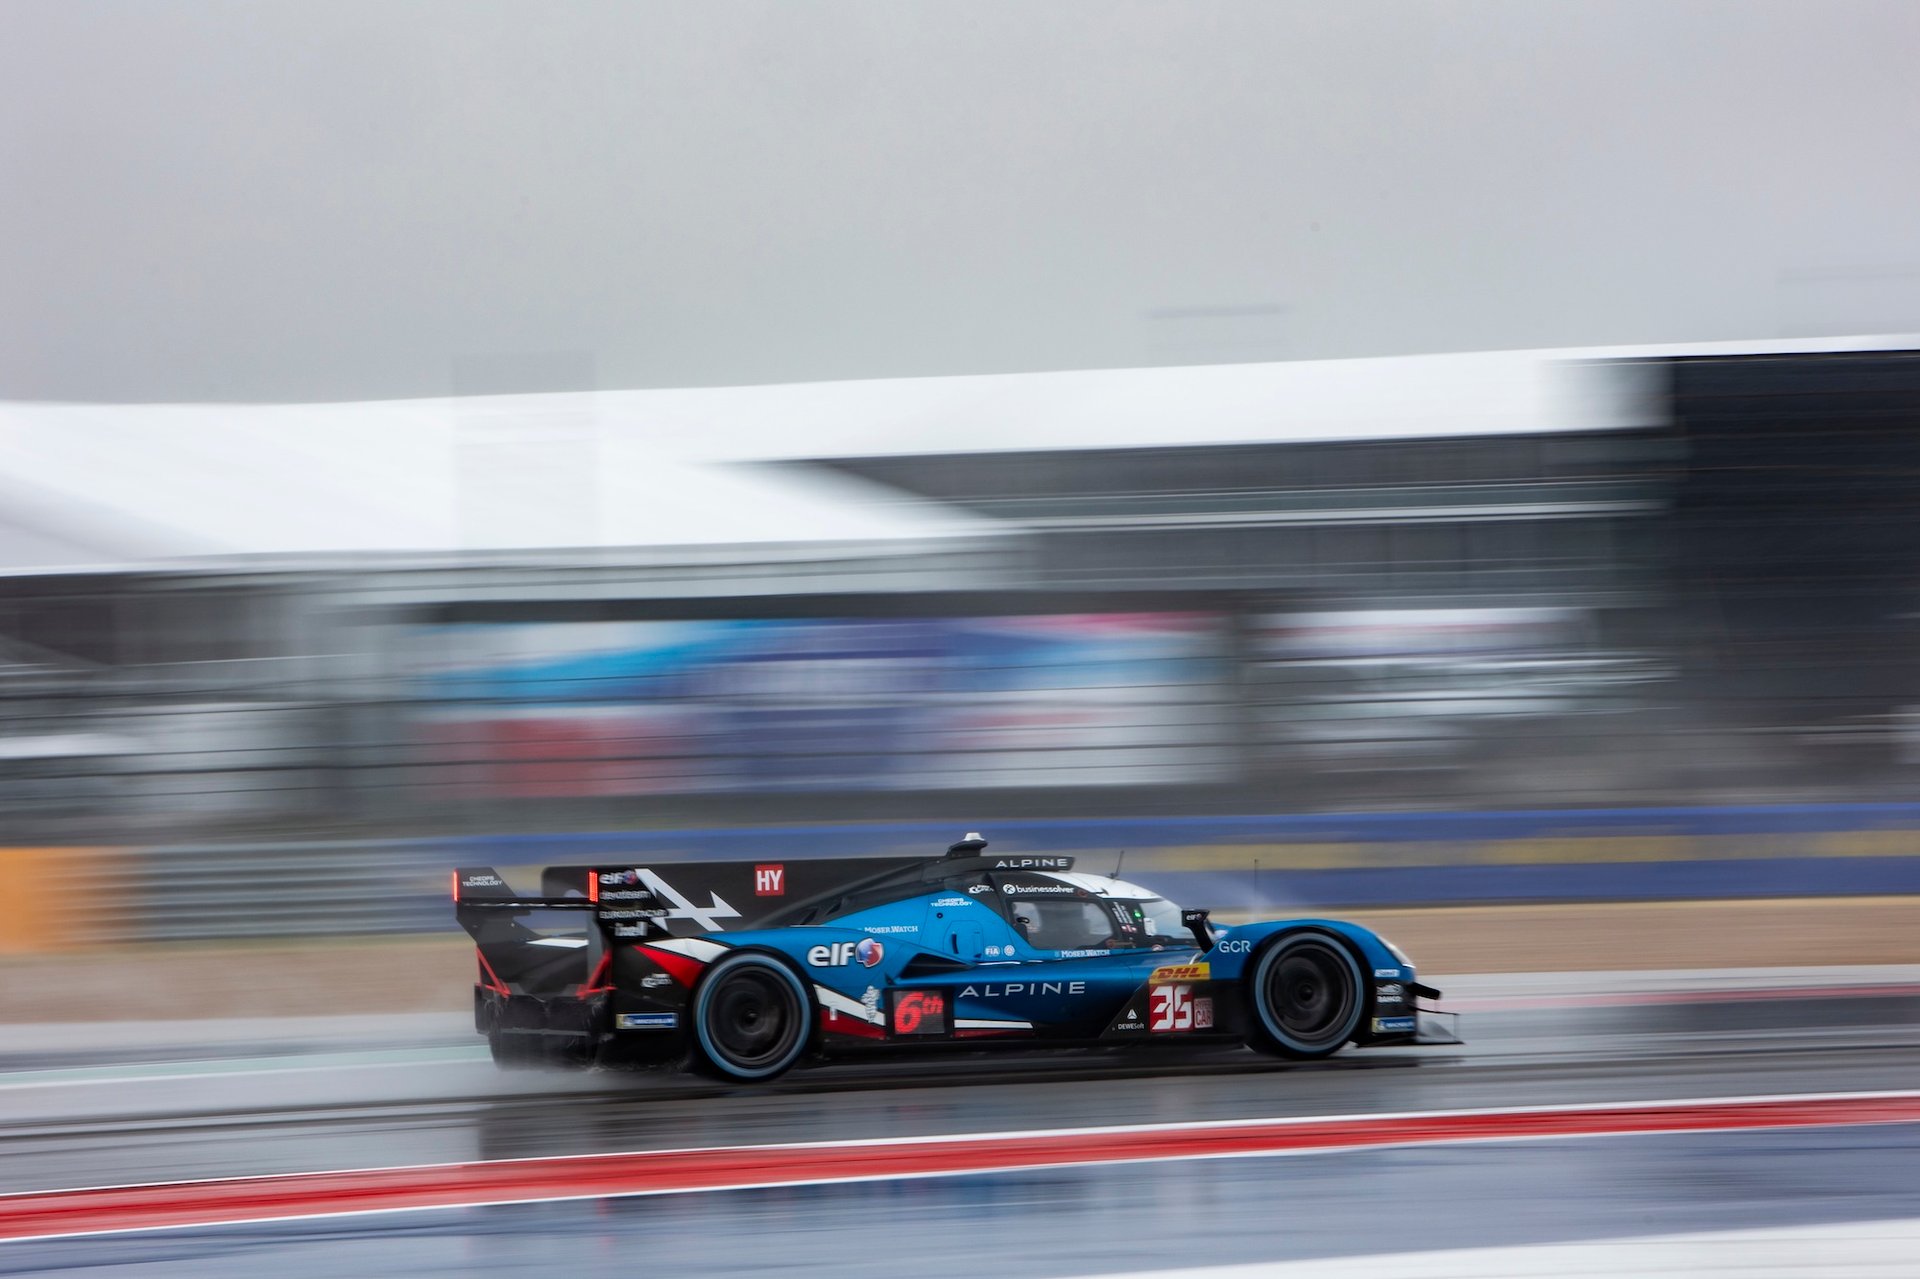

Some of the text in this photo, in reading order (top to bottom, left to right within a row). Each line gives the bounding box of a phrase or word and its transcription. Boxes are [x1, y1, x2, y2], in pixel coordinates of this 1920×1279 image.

[995, 859, 1068, 868] ALPINE
[599, 872, 624, 885] elf
[757, 870, 782, 891] HY
[1016, 885, 1075, 893] businessolver
[985, 947, 1000, 956] FIA
[1218, 940, 1251, 953] GCR
[807, 942, 856, 966] elf
[1158, 967, 1201, 979] DHL
[958, 982, 1086, 998] ALPINE
[894, 991, 945, 1034] 6th
[1151, 985, 1193, 1030] 35
[1195, 1010, 1212, 1026] CAR
